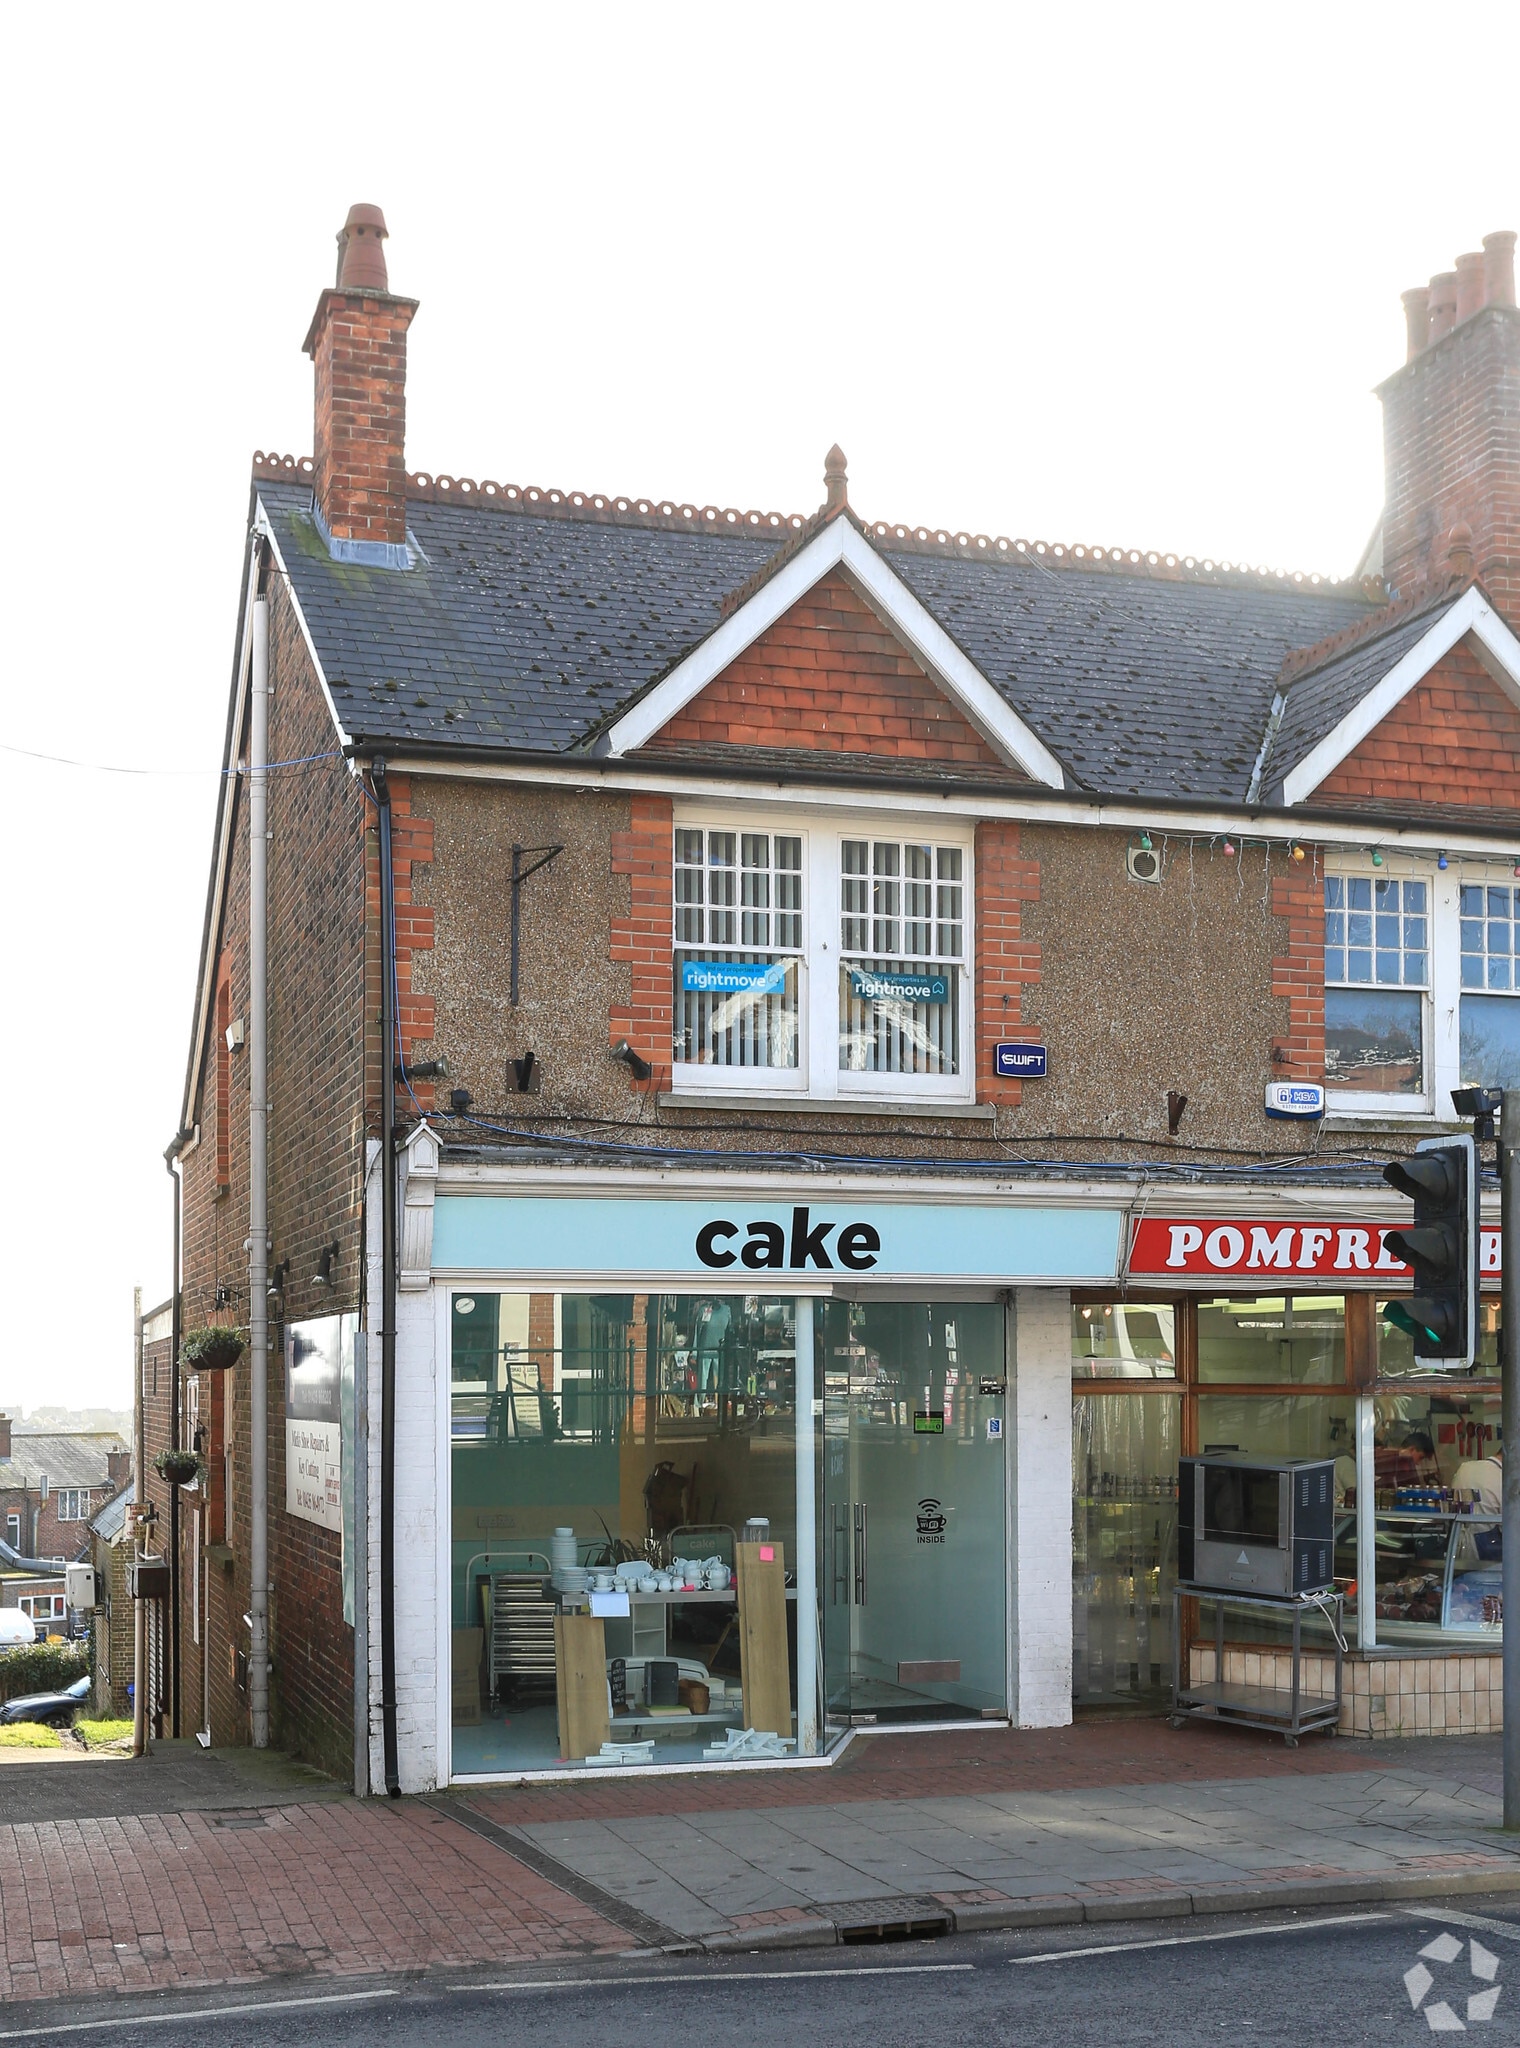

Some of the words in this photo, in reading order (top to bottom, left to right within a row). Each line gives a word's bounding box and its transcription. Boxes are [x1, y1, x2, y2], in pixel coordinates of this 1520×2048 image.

[687, 971, 766, 988] rightmove
[855, 980, 931, 997] rightmove
[1002, 1053, 1044, 1066] SWIFT
[1294, 1091, 1317, 1102] HSA
[695, 1207, 881, 1270] cake
[1165, 1225, 1408, 1271] POMFRE
[301, 1431, 309, 1449] Shoe
[310, 1432, 325, 1455] Repairs
[325, 1434, 330, 1453] &
[305, 1458, 320, 1483] Cutting
[689, 1539, 716, 1549] cake
[917, 1535, 946, 1544] INSIDE
